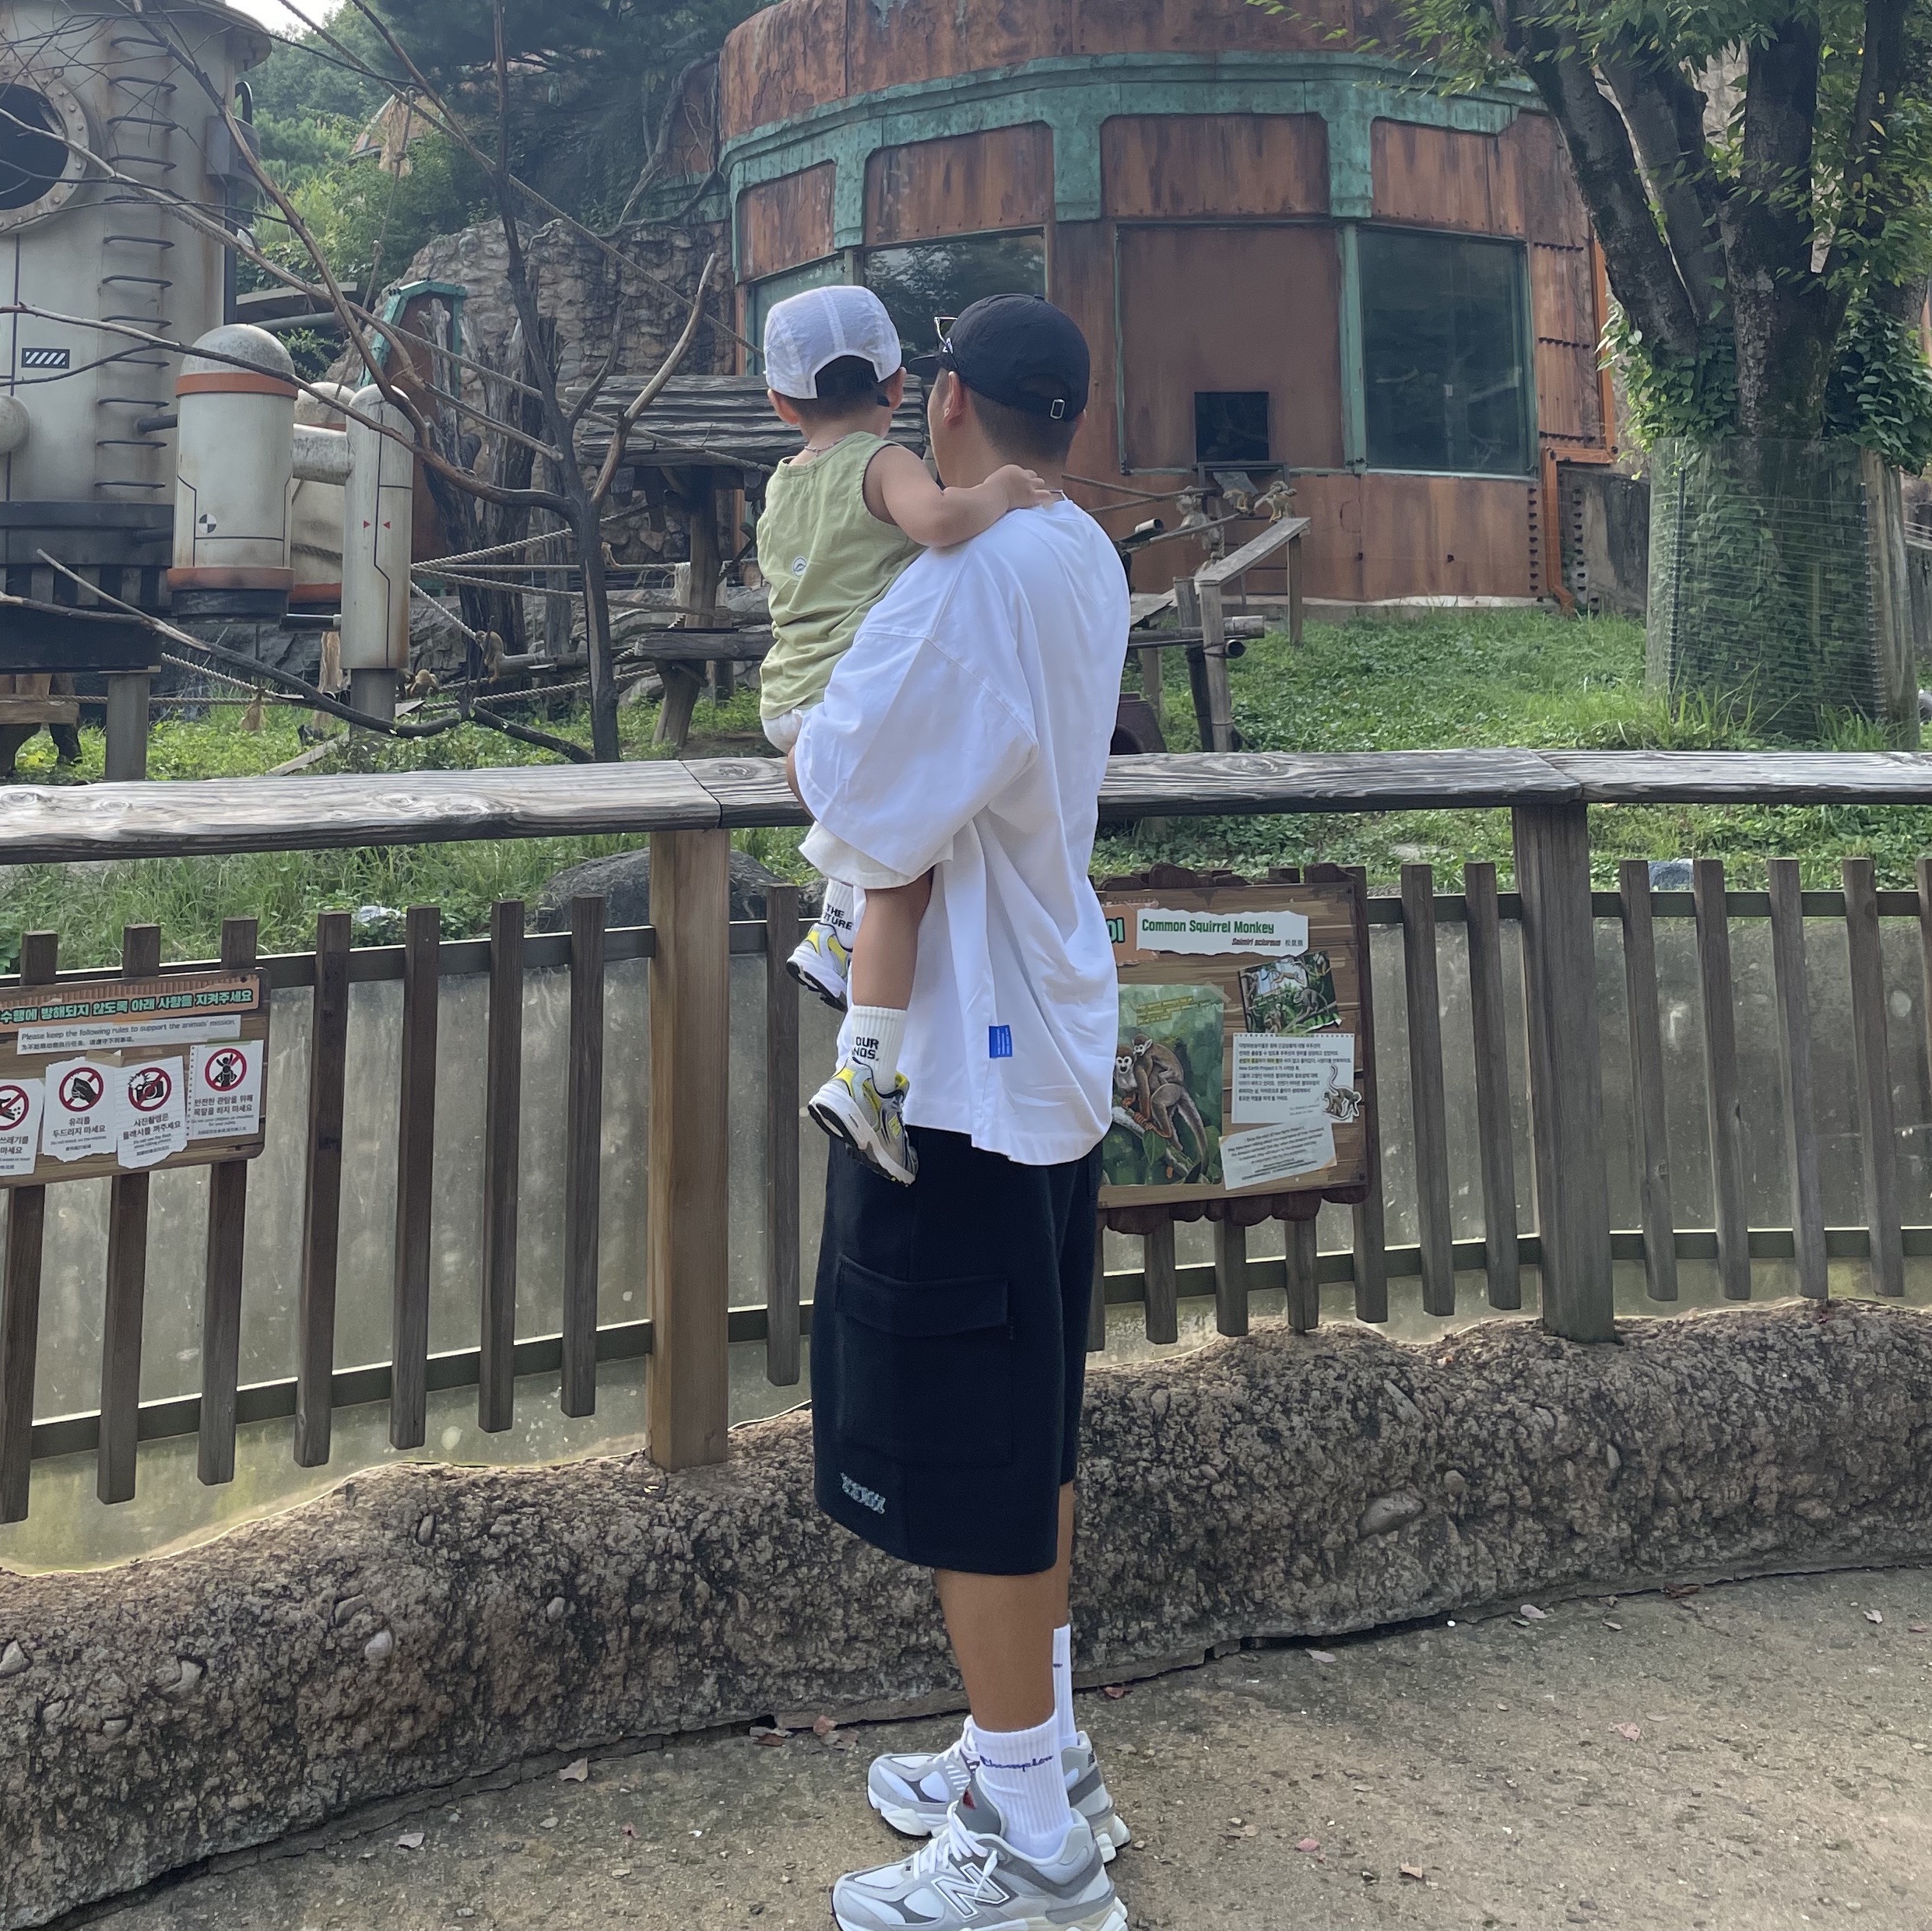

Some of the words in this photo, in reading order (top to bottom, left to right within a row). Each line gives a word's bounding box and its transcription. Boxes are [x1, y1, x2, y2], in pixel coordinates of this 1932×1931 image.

[827, 903, 845, 918] THE
[1142, 918, 1186, 932] Common
[1189, 920, 1231, 934] Squirrel
[1234, 921, 1274, 935] Monkey
[0, 1007, 38, 1024] 수행에
[40, 1002, 90, 1020] 방해되지
[92, 999, 129, 1016] 않도록
[130, 996, 156, 1013] 아래
[158, 993, 194, 1010] 사항을
[195, 988, 253, 1006] 지켜주세요
[79, 1028, 110, 1037] following
[140, 1023, 167, 1033] support
[855, 1036, 879, 1050] OUR
[195, 1097, 215, 1107] 안전한
[217, 1095, 237, 1105] 관람을
[216, 1105, 230, 1114] 하지
[232, 1104, 252, 1112] 마세요
[68, 1116, 90, 1126] 유리를
[134, 1113, 169, 1127] 사진촬영은
[53, 1127, 82, 1138] 두드리지
[83, 1125, 106, 1134] 마세요
[123, 1127, 151, 1139] 플래시를
[153, 1120, 181, 1133] 꺼주세요
[0, 1136, 29, 1145] 쓰레기를
